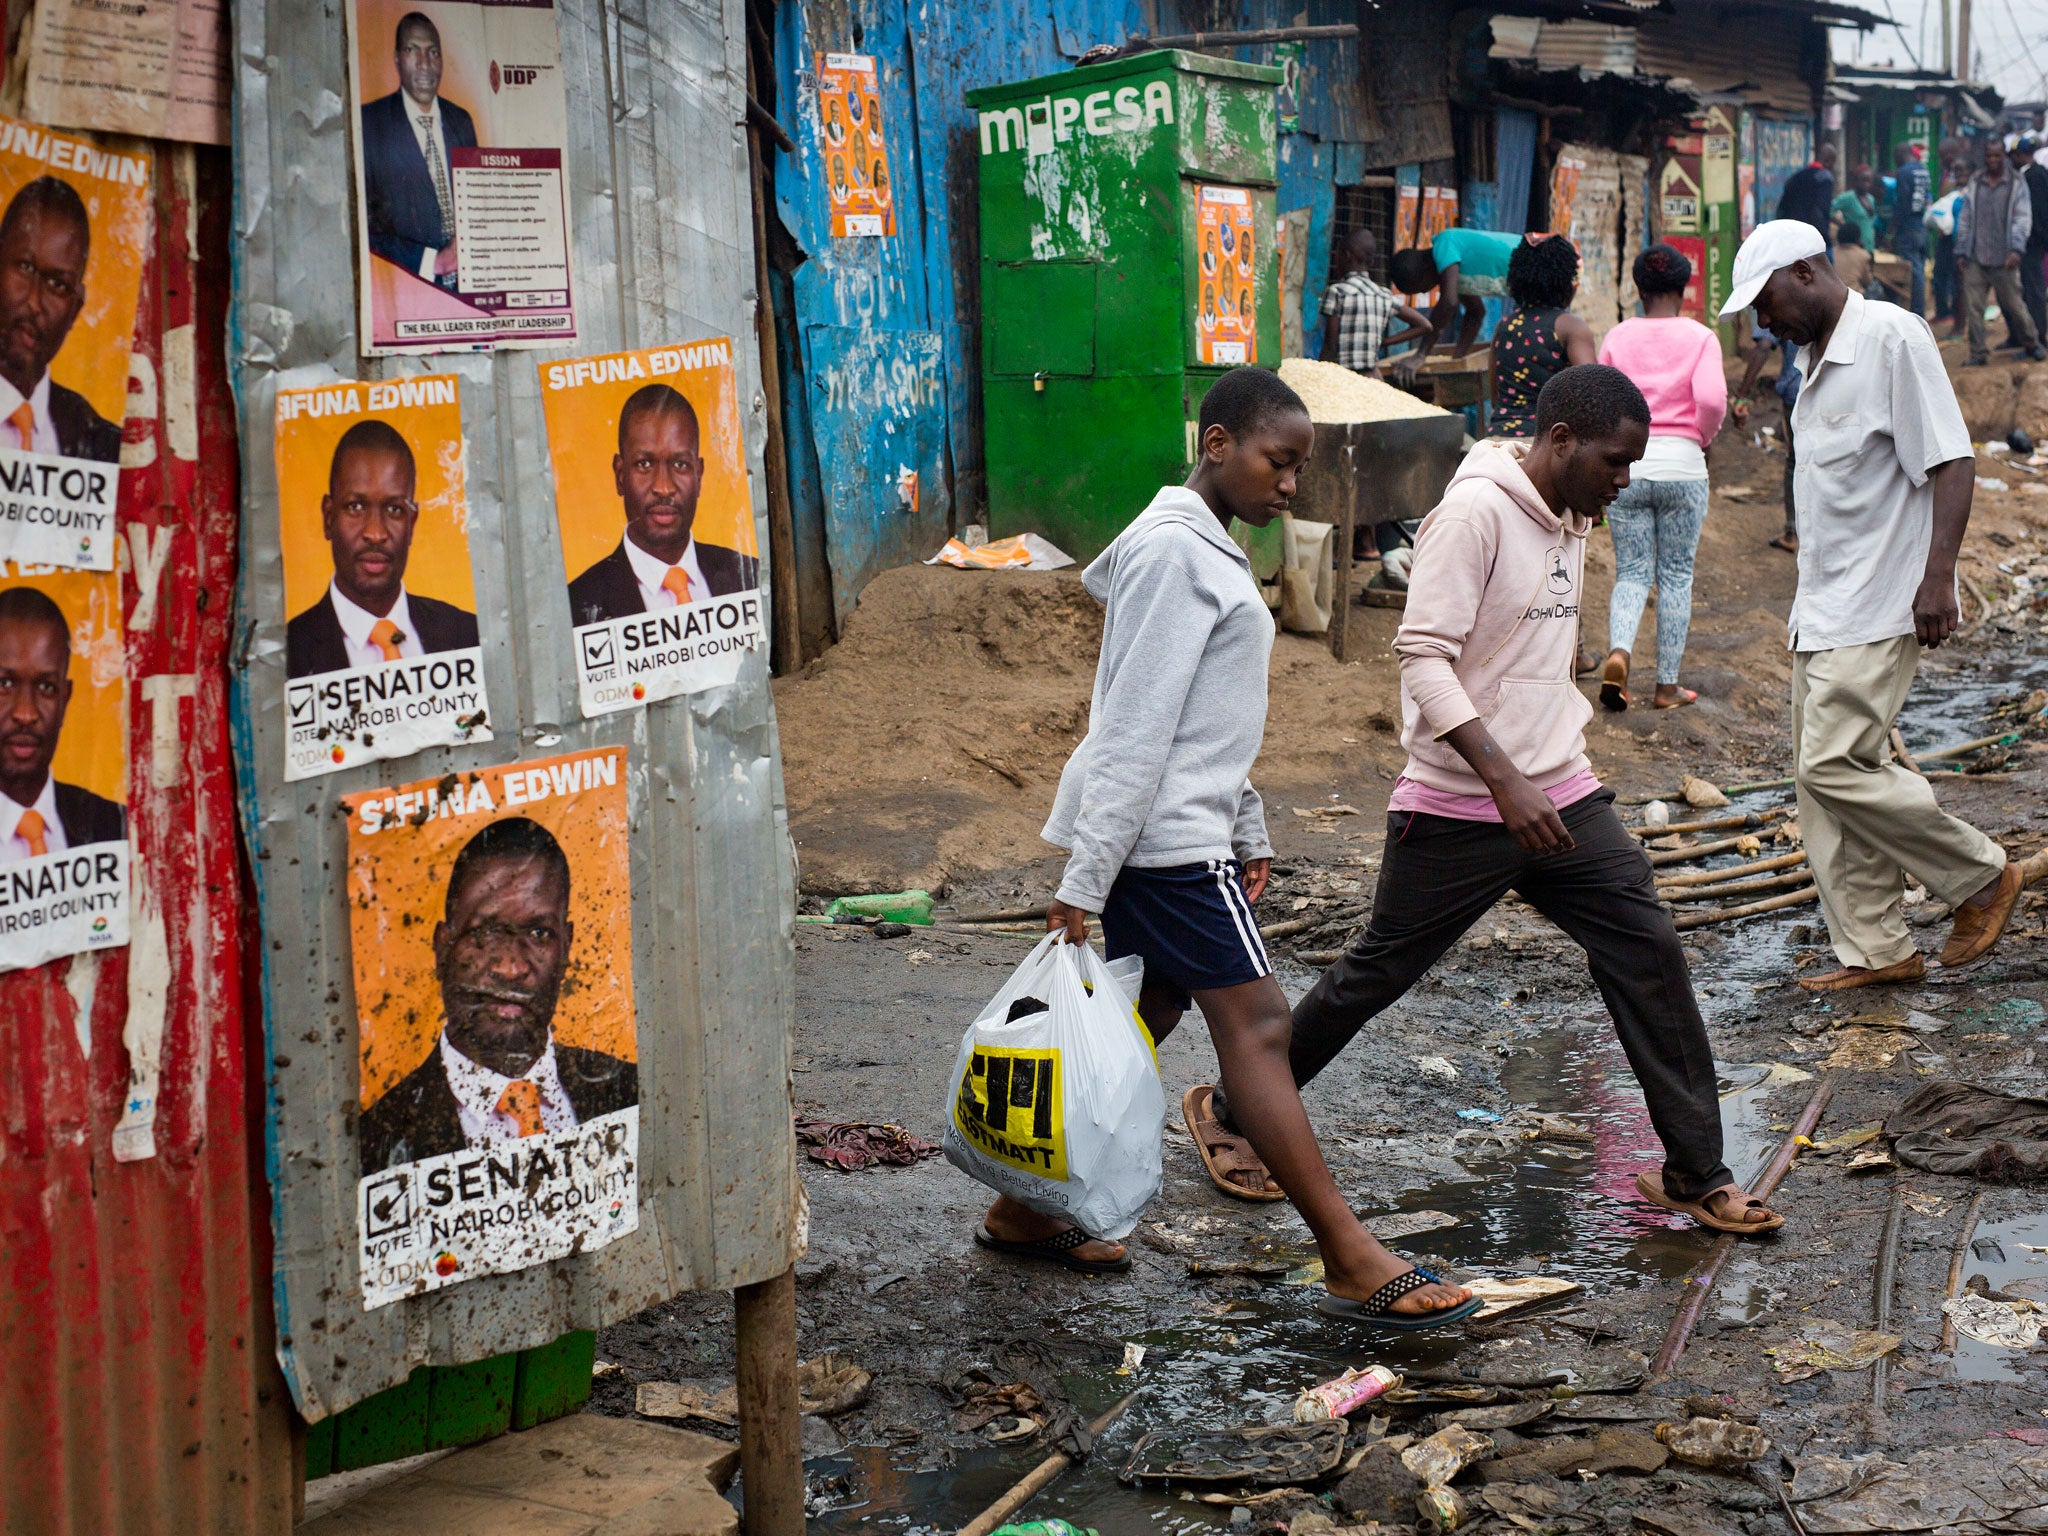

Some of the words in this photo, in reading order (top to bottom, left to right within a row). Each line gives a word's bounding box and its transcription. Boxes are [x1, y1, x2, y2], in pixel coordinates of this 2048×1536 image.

[503, 70, 537, 85] UDP
[403, 323, 418, 334] THE
[420, 322, 442, 333] REAL
[444, 321, 474, 332] LEADER
[549, 357, 645, 390] SIFUNA
[649, 343, 729, 377] EDWIN
[368, 380, 456, 412] EDWIN
[26, 506, 106, 531] COUNTY
[623, 599, 759, 652] SENATOR
[1518, 606, 1553, 621] JOHN
[587, 668, 617, 684] VOTE
[627, 646, 694, 675] NAIROBI
[326, 658, 477, 711] SENATOR
[594, 685, 630, 704] ODM
[327, 705, 401, 735] NAIROBI
[405, 692, 478, 720] COUNTY
[359, 779, 495, 836] SIFUNA
[503, 754, 617, 808] EDWIN
[51, 890, 121, 921] COUNTY
[956, 1107, 1054, 1170] EASTMATT
[427, 1122, 628, 1208] SENATOR
[1001, 1168, 1033, 1193] Better
[1035, 1182, 1069, 1207] Living
[430, 1196, 539, 1239] NAIROBI
[547, 1169, 630, 1214] COUNTY
[364, 1232, 413, 1259] VOTE
[378, 1256, 433, 1287] ODM
